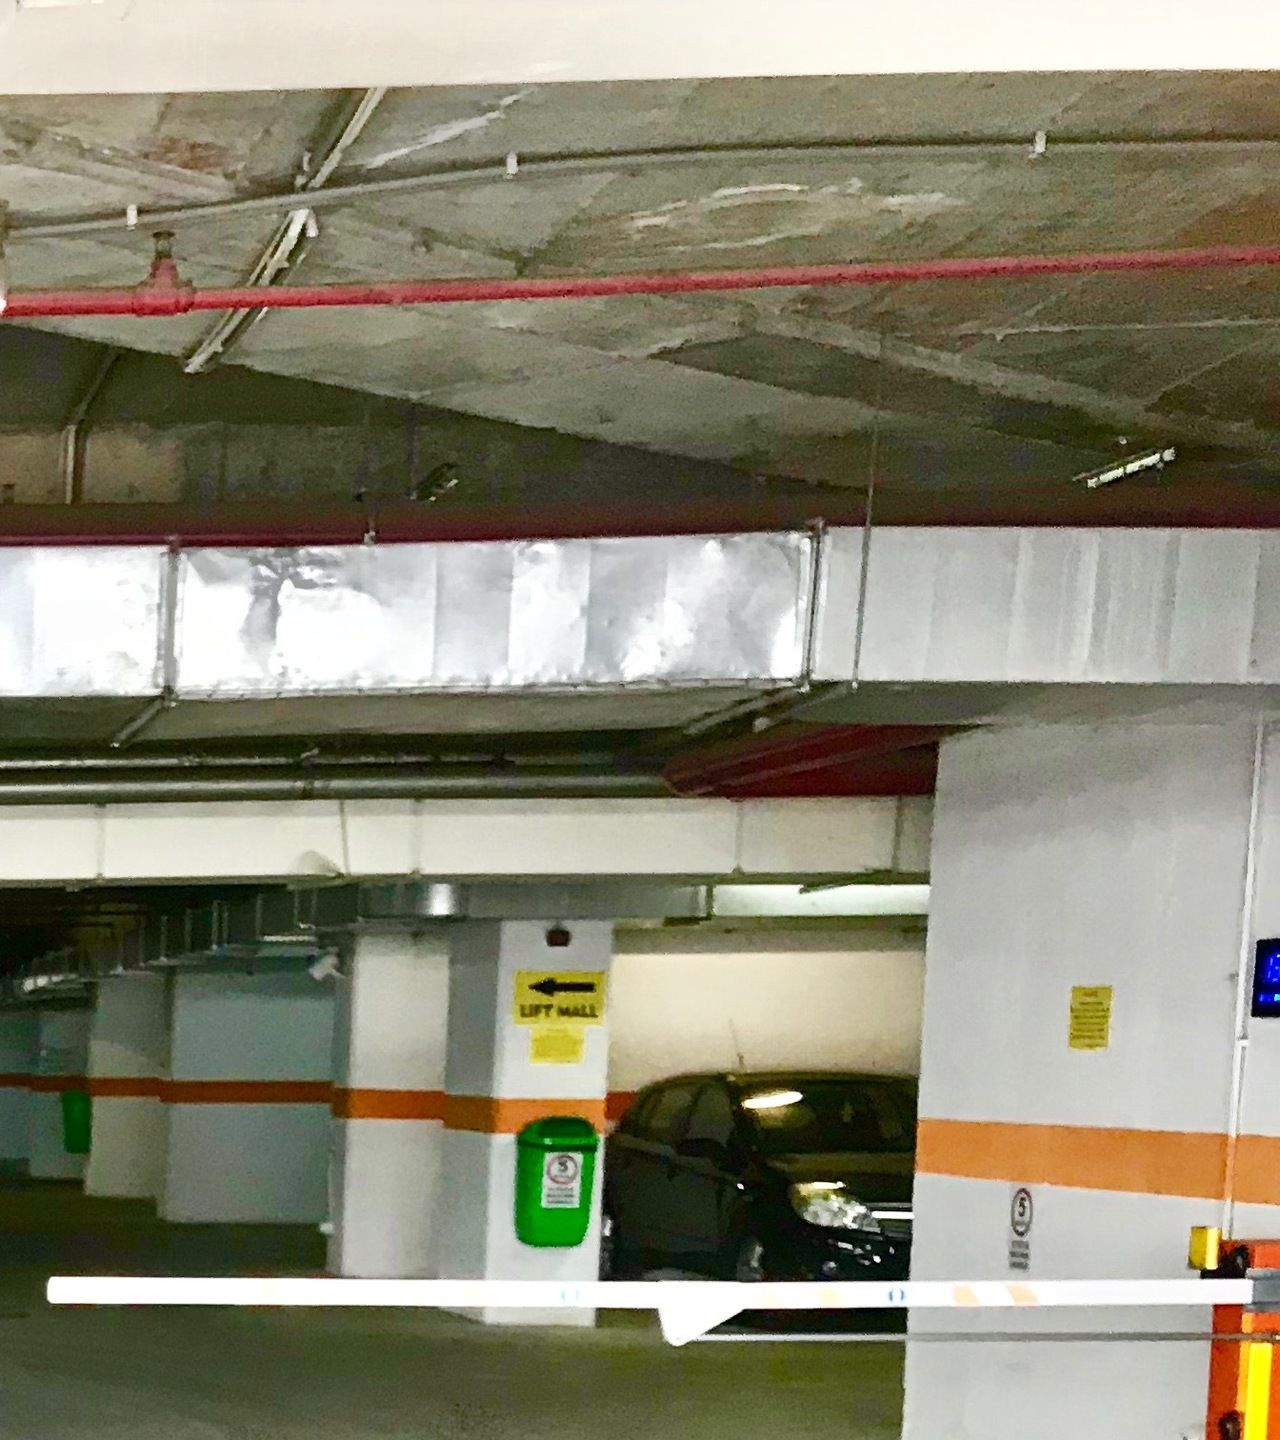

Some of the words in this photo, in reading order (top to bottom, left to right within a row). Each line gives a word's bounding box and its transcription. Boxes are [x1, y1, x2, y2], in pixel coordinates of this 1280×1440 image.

[520, 1003, 553, 1018] LIFT
[557, 1003, 598, 1018] MALL
[1018, 1196, 1027, 1217] 5
